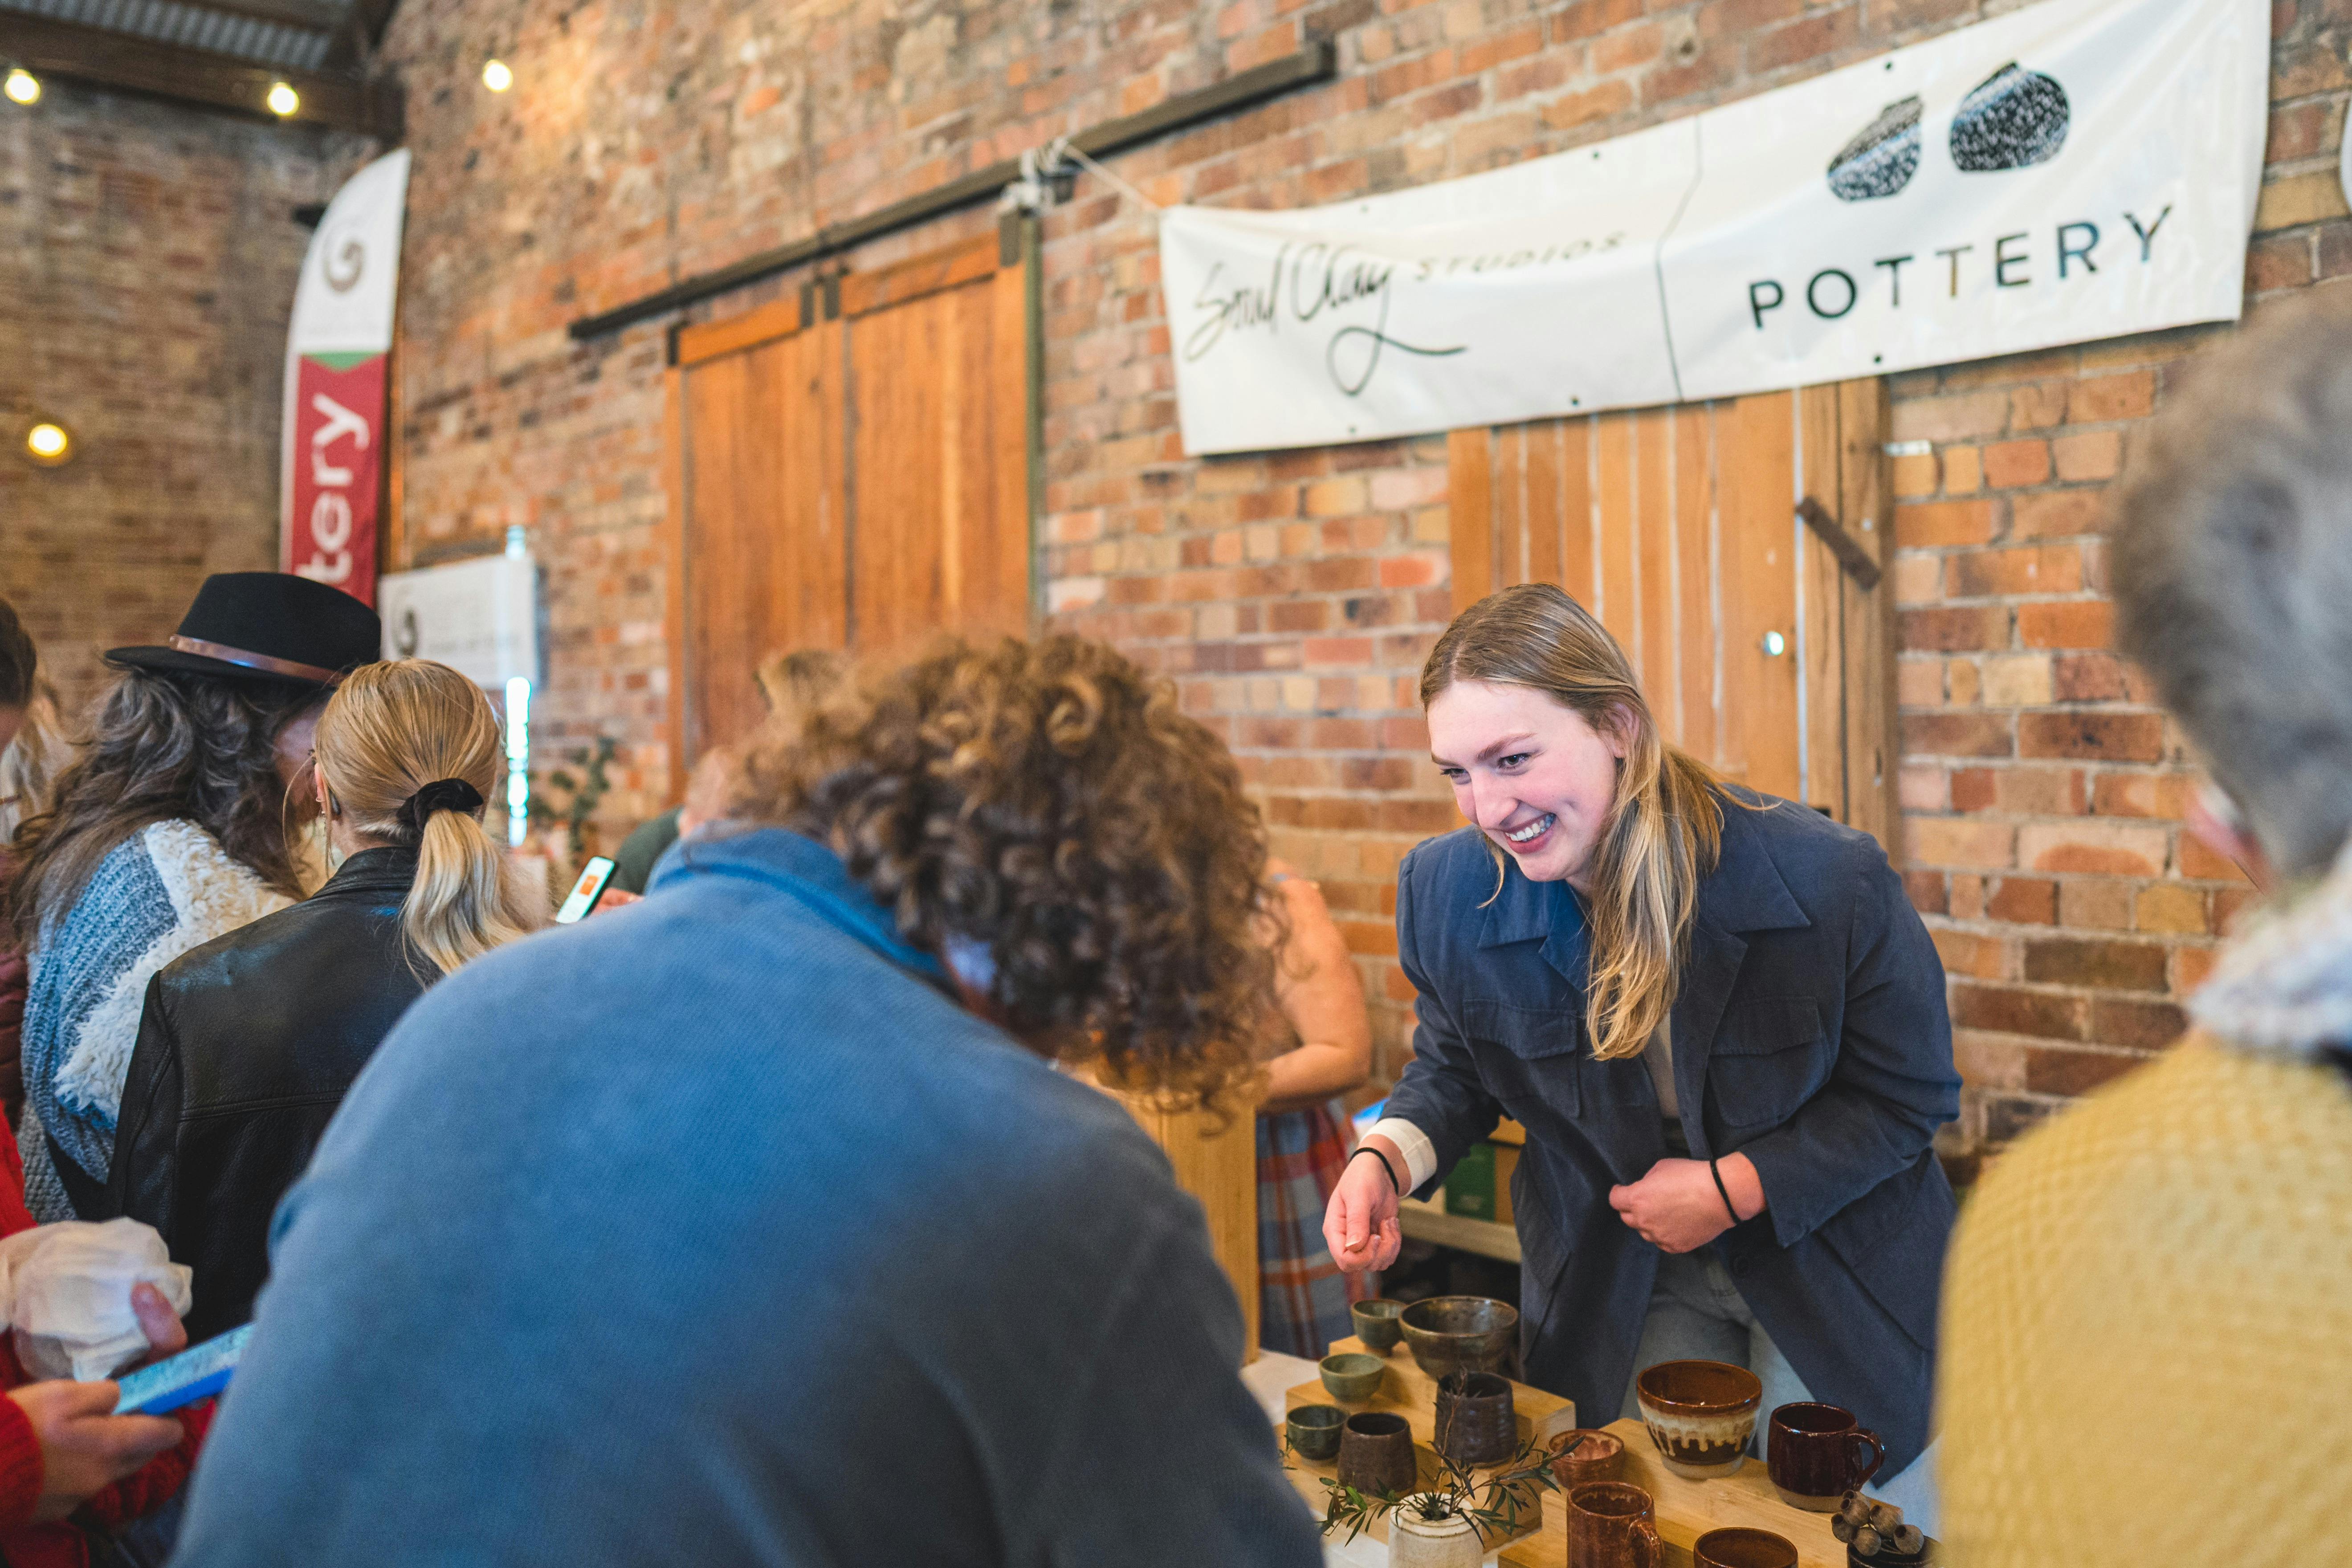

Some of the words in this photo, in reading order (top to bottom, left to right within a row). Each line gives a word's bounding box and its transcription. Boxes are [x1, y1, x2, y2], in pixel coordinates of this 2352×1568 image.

[1291, 243, 1468, 396] Clay
[1413, 230, 1628, 281] STUDIOS
[1749, 204, 2173, 329] POTTERY
[295, 393, 371, 593] tery
